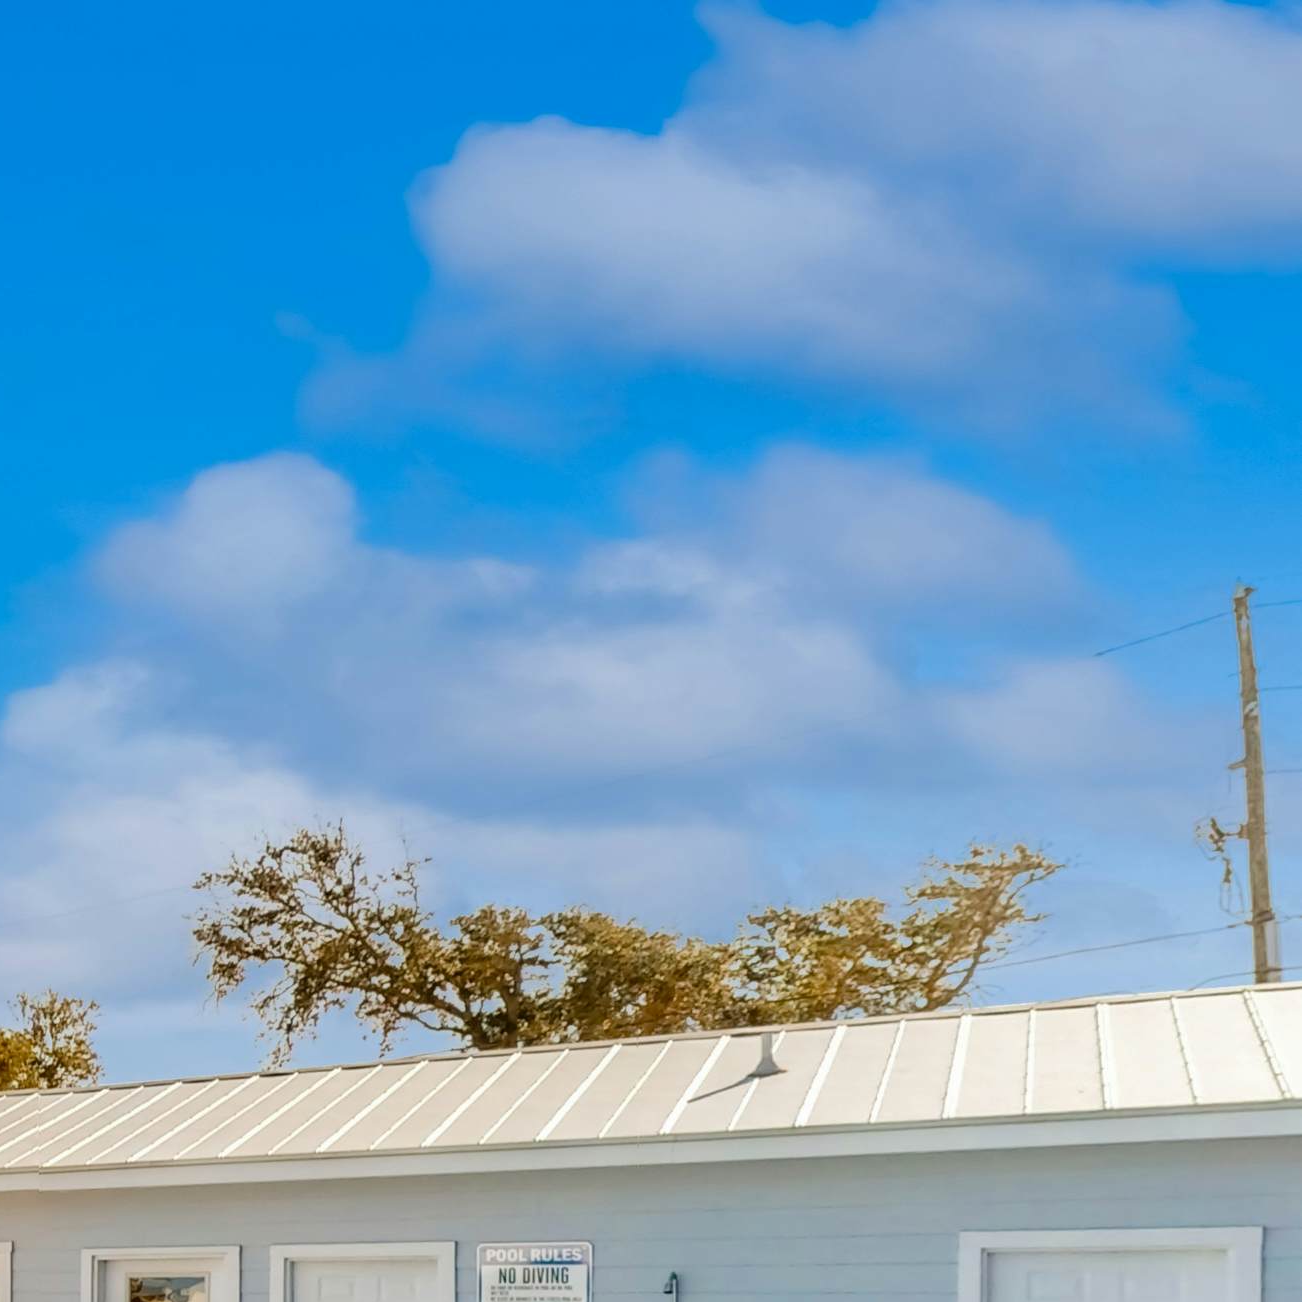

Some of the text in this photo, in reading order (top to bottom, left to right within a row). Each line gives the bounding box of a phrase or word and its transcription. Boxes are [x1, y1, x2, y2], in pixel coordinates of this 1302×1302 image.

[486, 1248, 583, 1262] POOL RULES
[498, 1267, 570, 1284] NO DIVING
